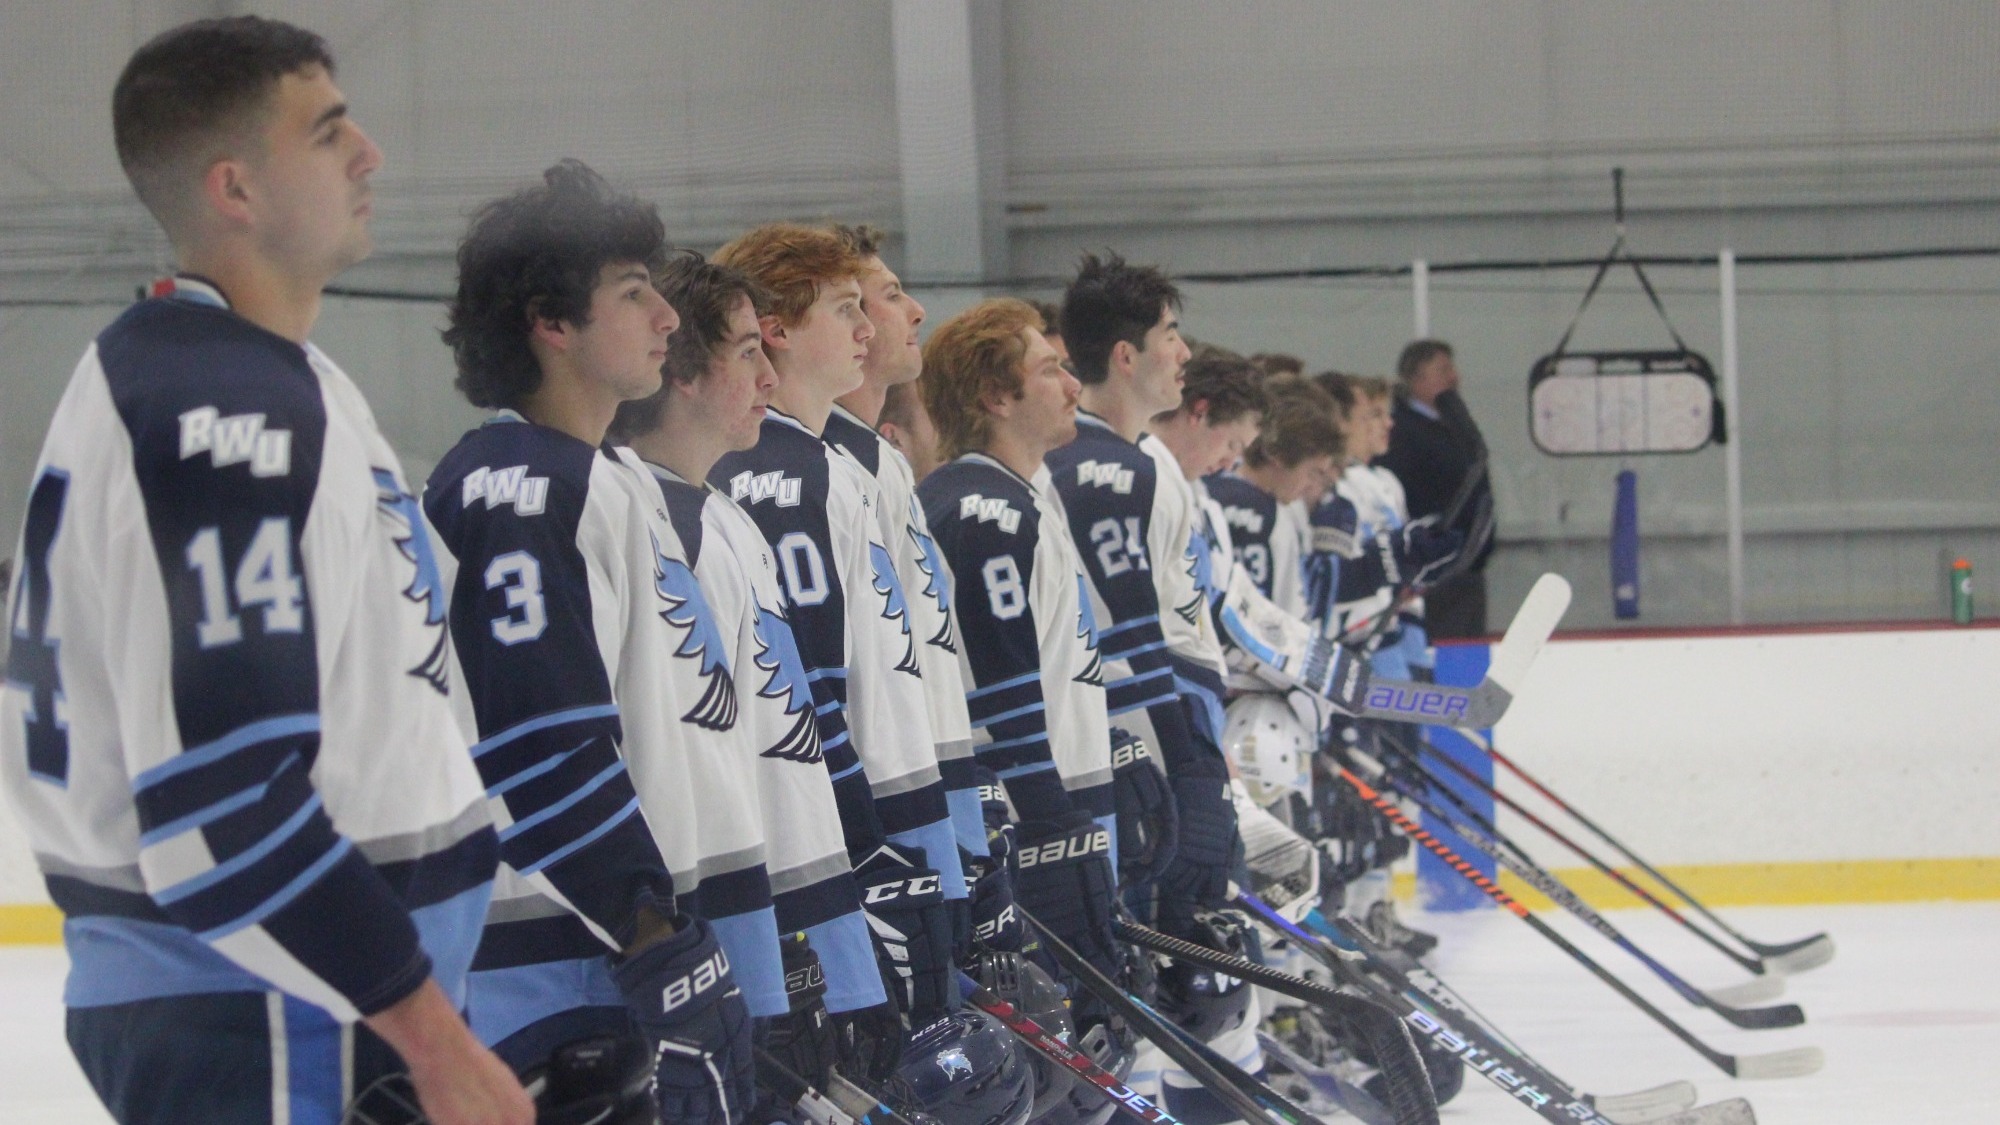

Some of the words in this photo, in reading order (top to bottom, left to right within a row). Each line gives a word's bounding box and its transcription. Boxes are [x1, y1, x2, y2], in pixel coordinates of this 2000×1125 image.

[178, 406, 292, 478] RWU
[462, 465, 549, 517] RWU
[730, 470, 801, 508] RWU
[1077, 459, 1135, 494] RWU
[960, 493, 1022, 535] RWU
[186, 516, 304, 650] 14
[771, 531, 830, 608] 0
[981, 554, 1027, 621] 8
[484, 550, 548, 647] 3
[1365, 684, 1471, 718] AUER
[864, 874, 942, 904] CC
[1106, 1084, 1183, 1125] JET
